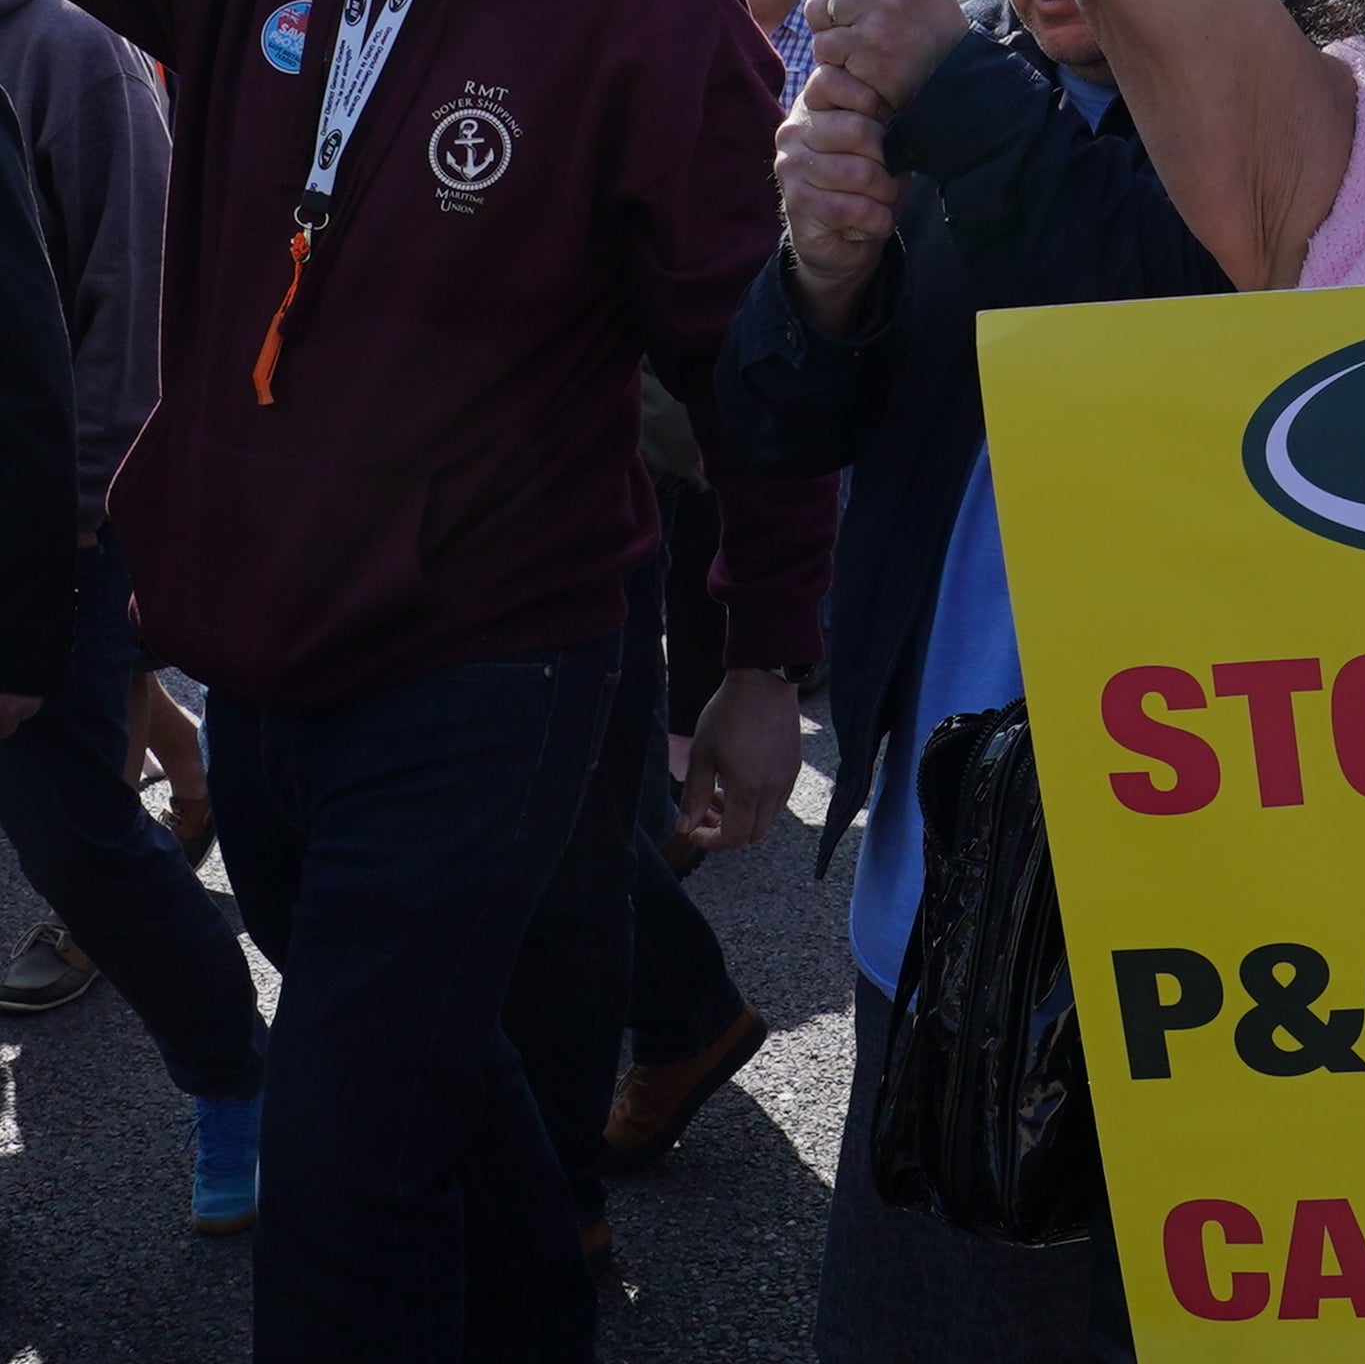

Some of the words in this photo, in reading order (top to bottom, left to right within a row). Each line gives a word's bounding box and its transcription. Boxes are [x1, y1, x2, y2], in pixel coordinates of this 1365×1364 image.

[464, 80, 509, 101] RMT
[432, 98, 473, 120] DOVER
[477, 99, 523, 138] SHIPPING
[440, 199, 475, 214] UNION
